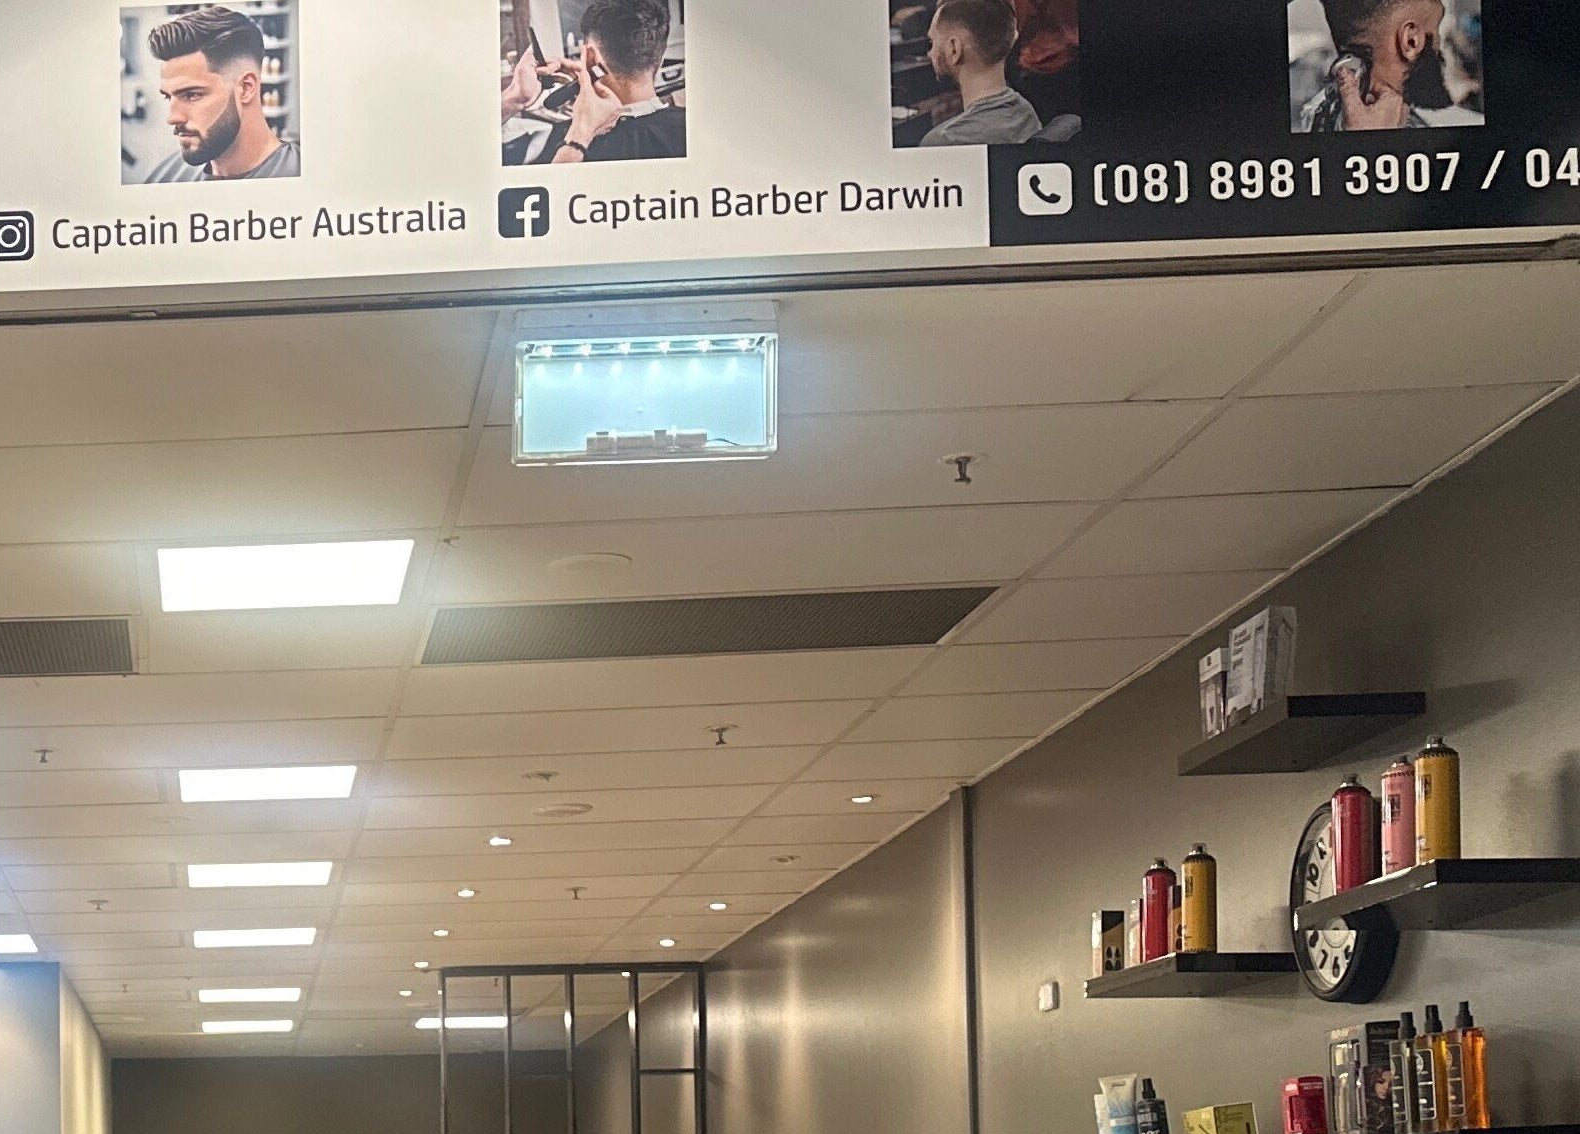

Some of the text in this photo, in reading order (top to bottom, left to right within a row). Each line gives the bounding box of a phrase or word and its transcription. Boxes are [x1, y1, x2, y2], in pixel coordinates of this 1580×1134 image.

[567, 175, 964, 231] Captain Barber Darwin
[1093, 147, 1580, 206] (08) 8981 3907 / 04
[51, 201, 467, 256] Captain Barber Australia
